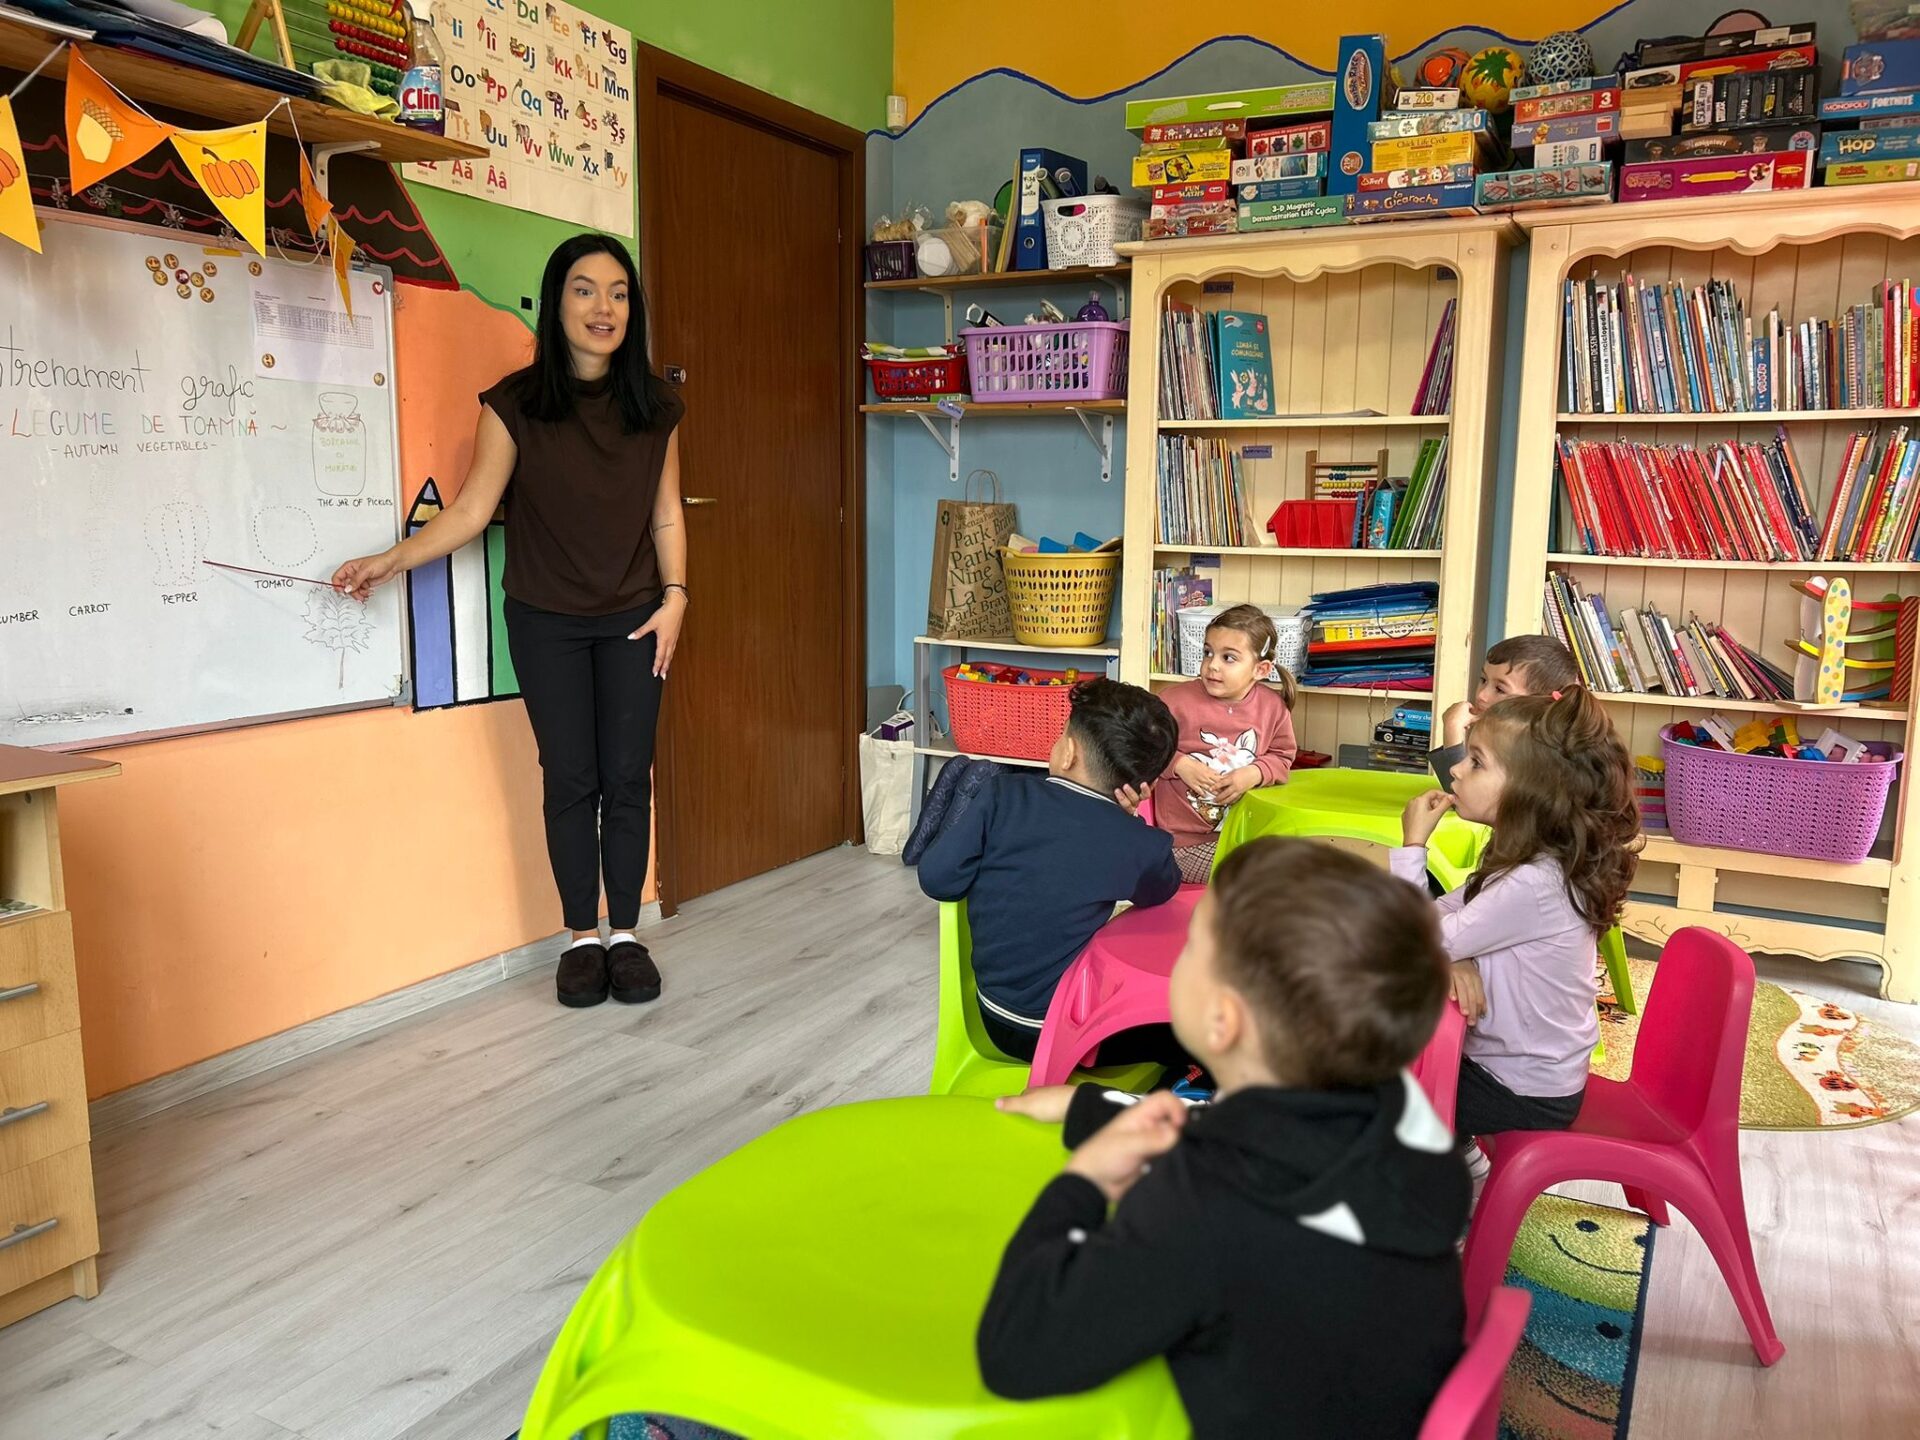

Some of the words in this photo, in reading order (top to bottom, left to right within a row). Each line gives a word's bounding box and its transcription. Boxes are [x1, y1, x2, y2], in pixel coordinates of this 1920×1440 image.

[552, 15, 570, 37] Ee
[608, 40, 627, 65] Gg
[452, 17, 463, 39] Ii
[554, 57, 573, 81] Kk
[604, 77, 629, 101] Mm
[402, 86, 440, 110] Clin
[450, 64, 476, 88] Oo
[487, 76, 508, 103] Pp
[521, 89, 542, 117] Qq
[554, 100, 569, 121] Rr
[582, 111, 598, 131] Ss
[1415, 92, 1434, 104] 70
[1601, 91, 1612, 106] 3
[1823, 100, 1870, 112] MONOPOLY
[1871, 94, 1915, 109] FORTNITE
[1739, 98, 1749, 120] VIRUS
[1513, 125, 1534, 134] Disney
[1396, 139, 1415, 149] Chick
[1430, 136, 1448, 147] Cycle
[485, 124, 508, 148] Uu
[523, 136, 543, 158] Vv
[548, 142, 574, 168] Ww
[582, 155, 600, 176] Xx
[613, 166, 628, 187] Yy
[1185, 184, 1200, 192] FUN
[1251, 211, 1299, 224] Demonstration
[1300, 208, 1314, 219] Life
[1315, 205, 1337, 217] Cycles
[1271, 205, 1284, 214] 3-D
[1286, 201, 1316, 212] Magnetic
[1590, 335, 1599, 357] DESEN
[0, 324, 152, 393] trenament
[181, 364, 255, 418] grafic
[12, 408, 116, 438] LEGUME
[141, 414, 165, 435] DE
[178, 410, 259, 437] TOAMNĂ
[317, 498, 334, 507] THE
[336, 498, 349, 507] JAR
[353, 498, 363, 507] OF
[254, 579, 294, 589] TOMATO
[950, 566, 993, 587] Nine
[161, 591, 198, 605] PEPPER
[947, 588, 977, 608] La
[68, 603, 111, 617] CARROT
[946, 604, 978, 623] Park
